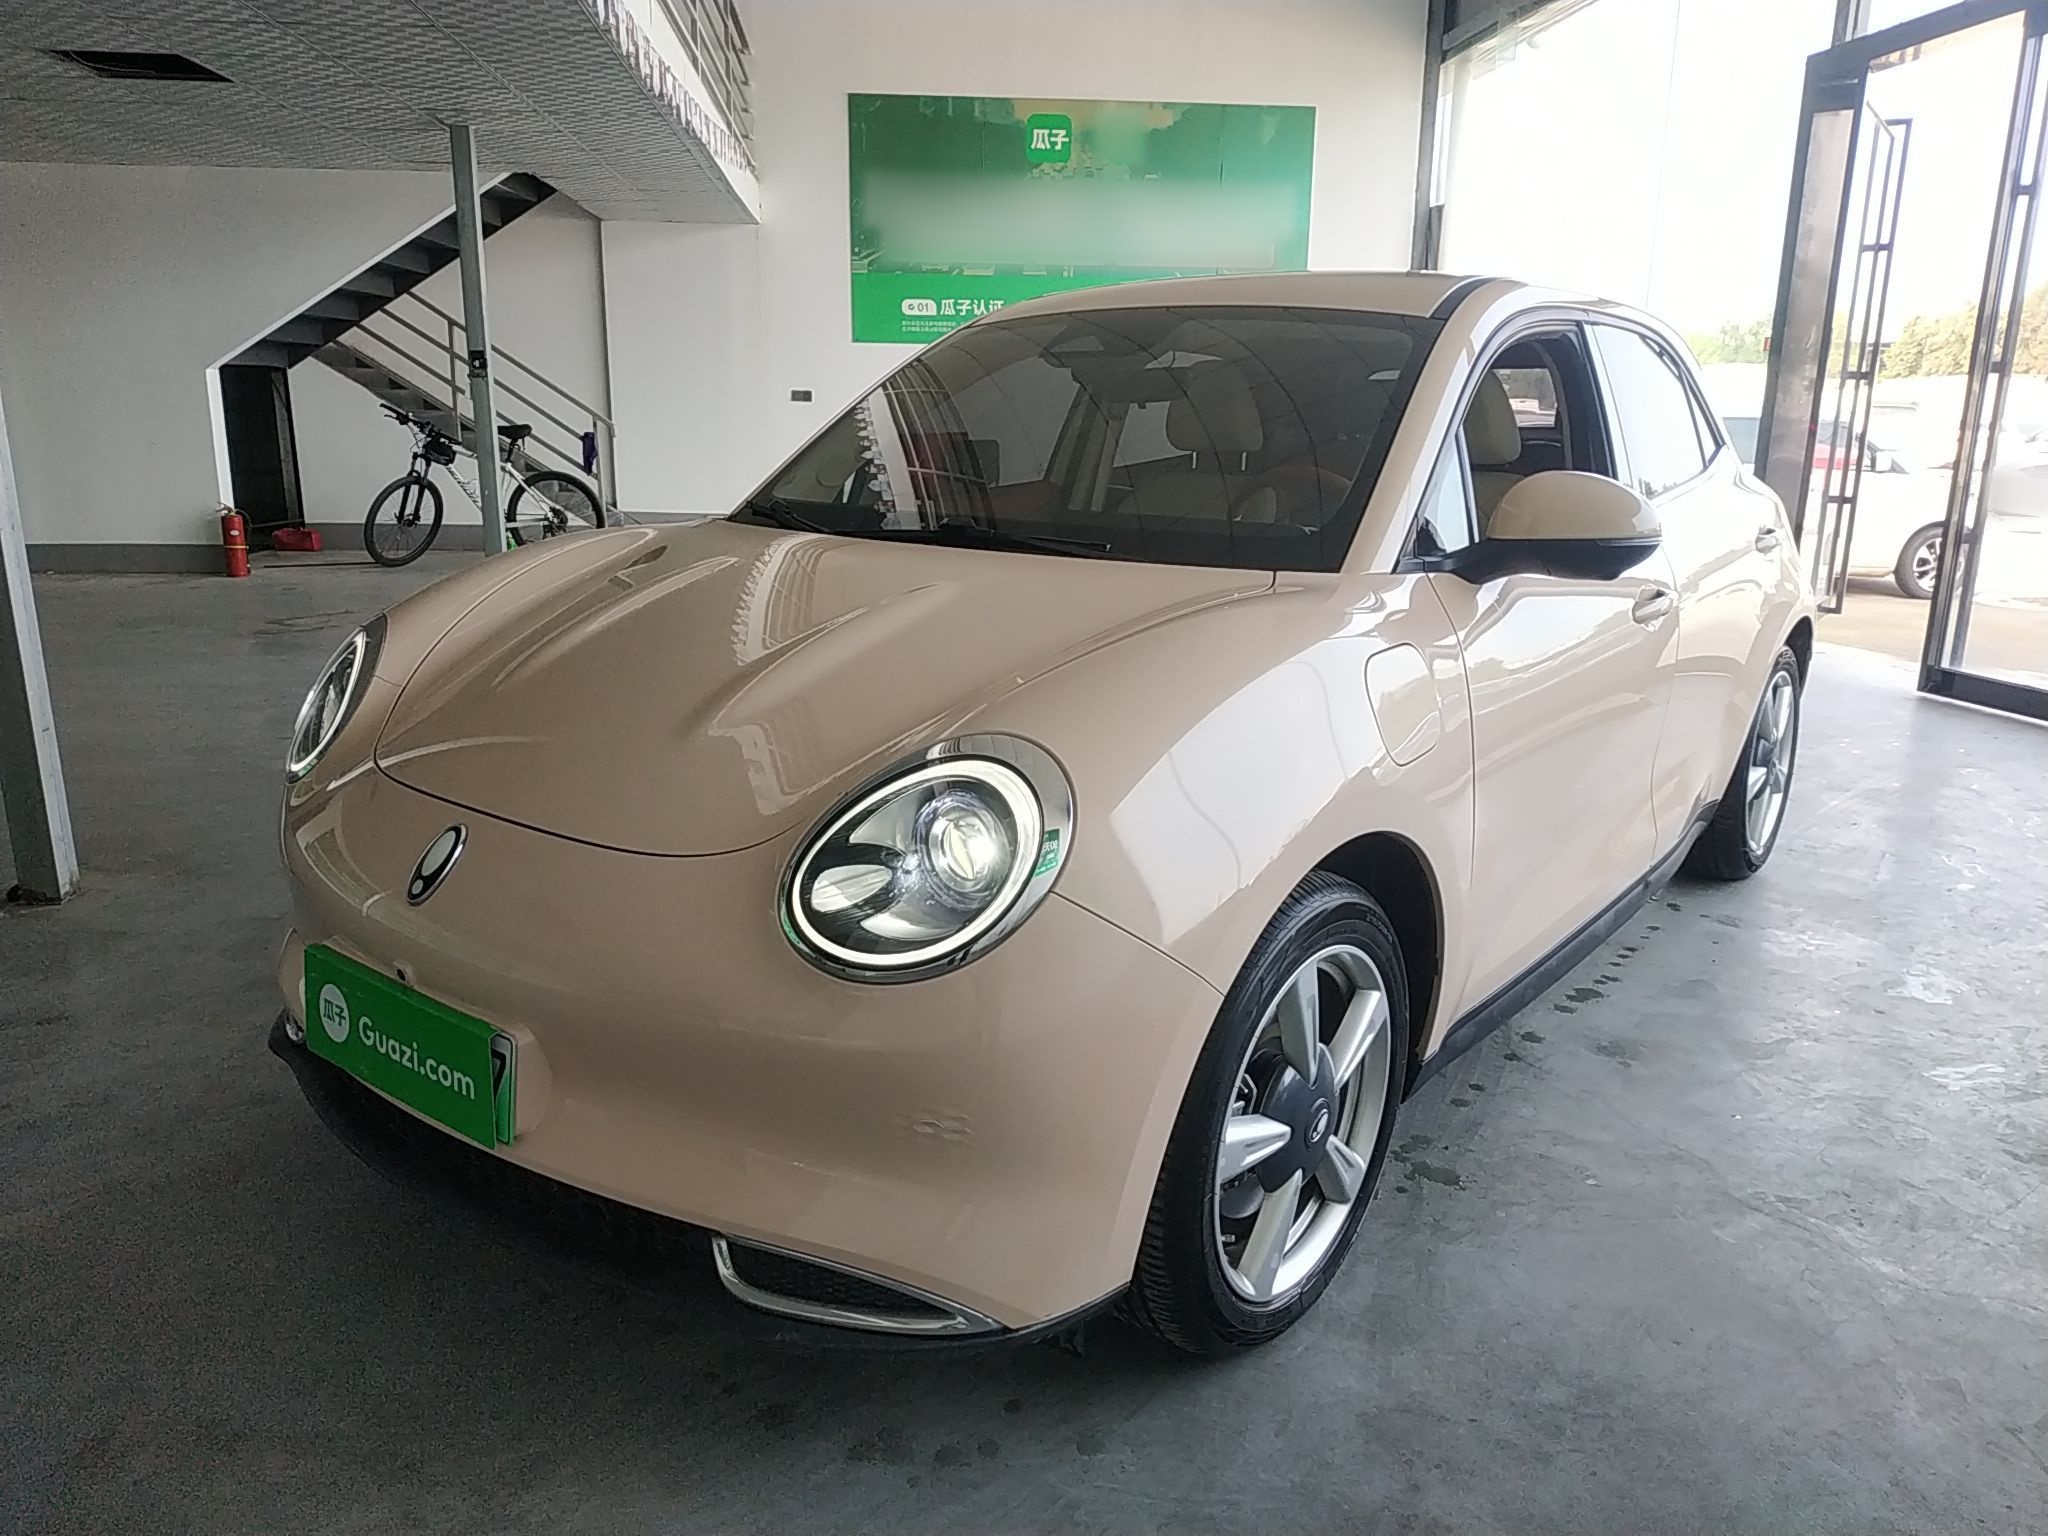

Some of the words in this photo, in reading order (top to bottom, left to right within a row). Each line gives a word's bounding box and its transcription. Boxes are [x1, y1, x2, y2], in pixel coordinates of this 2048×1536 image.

[1031, 129, 1069, 150] 瓜子
[323, 998, 346, 1027] 瓜子
[358, 1016, 475, 1100] Guazi.com
